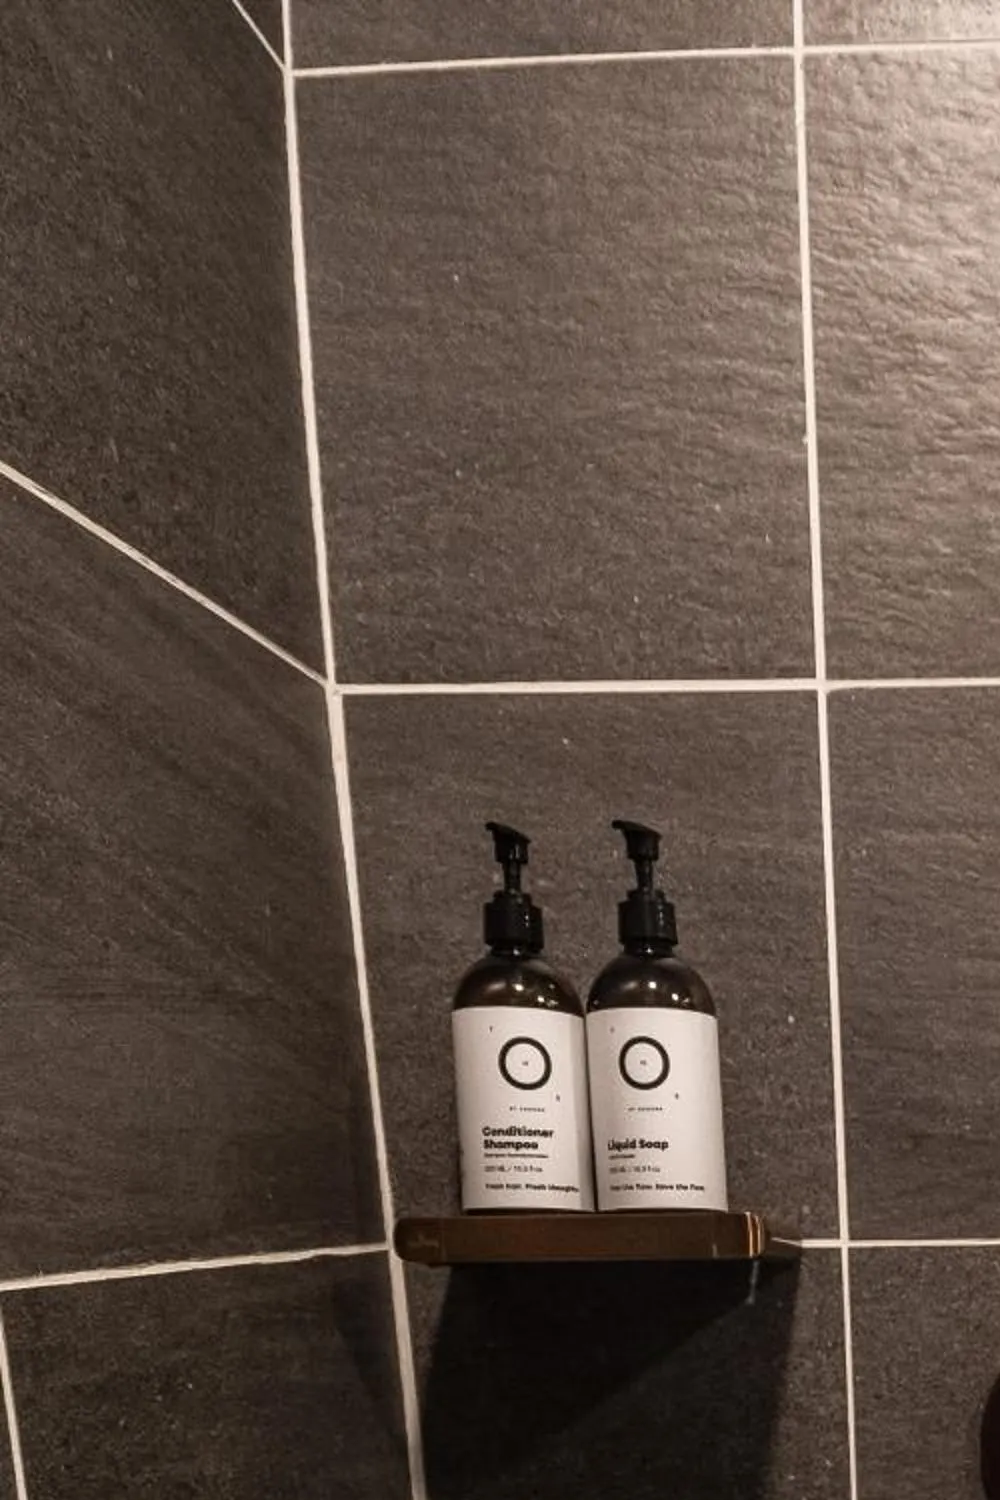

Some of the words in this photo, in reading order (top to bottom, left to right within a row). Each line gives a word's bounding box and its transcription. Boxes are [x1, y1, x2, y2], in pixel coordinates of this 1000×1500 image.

[482, 1126, 554, 1138] Conditioner
[483, 1140, 539, 1151] Shampoo
[607, 1138, 636, 1151] Liquid
[638, 1138, 669, 1152] Soap
